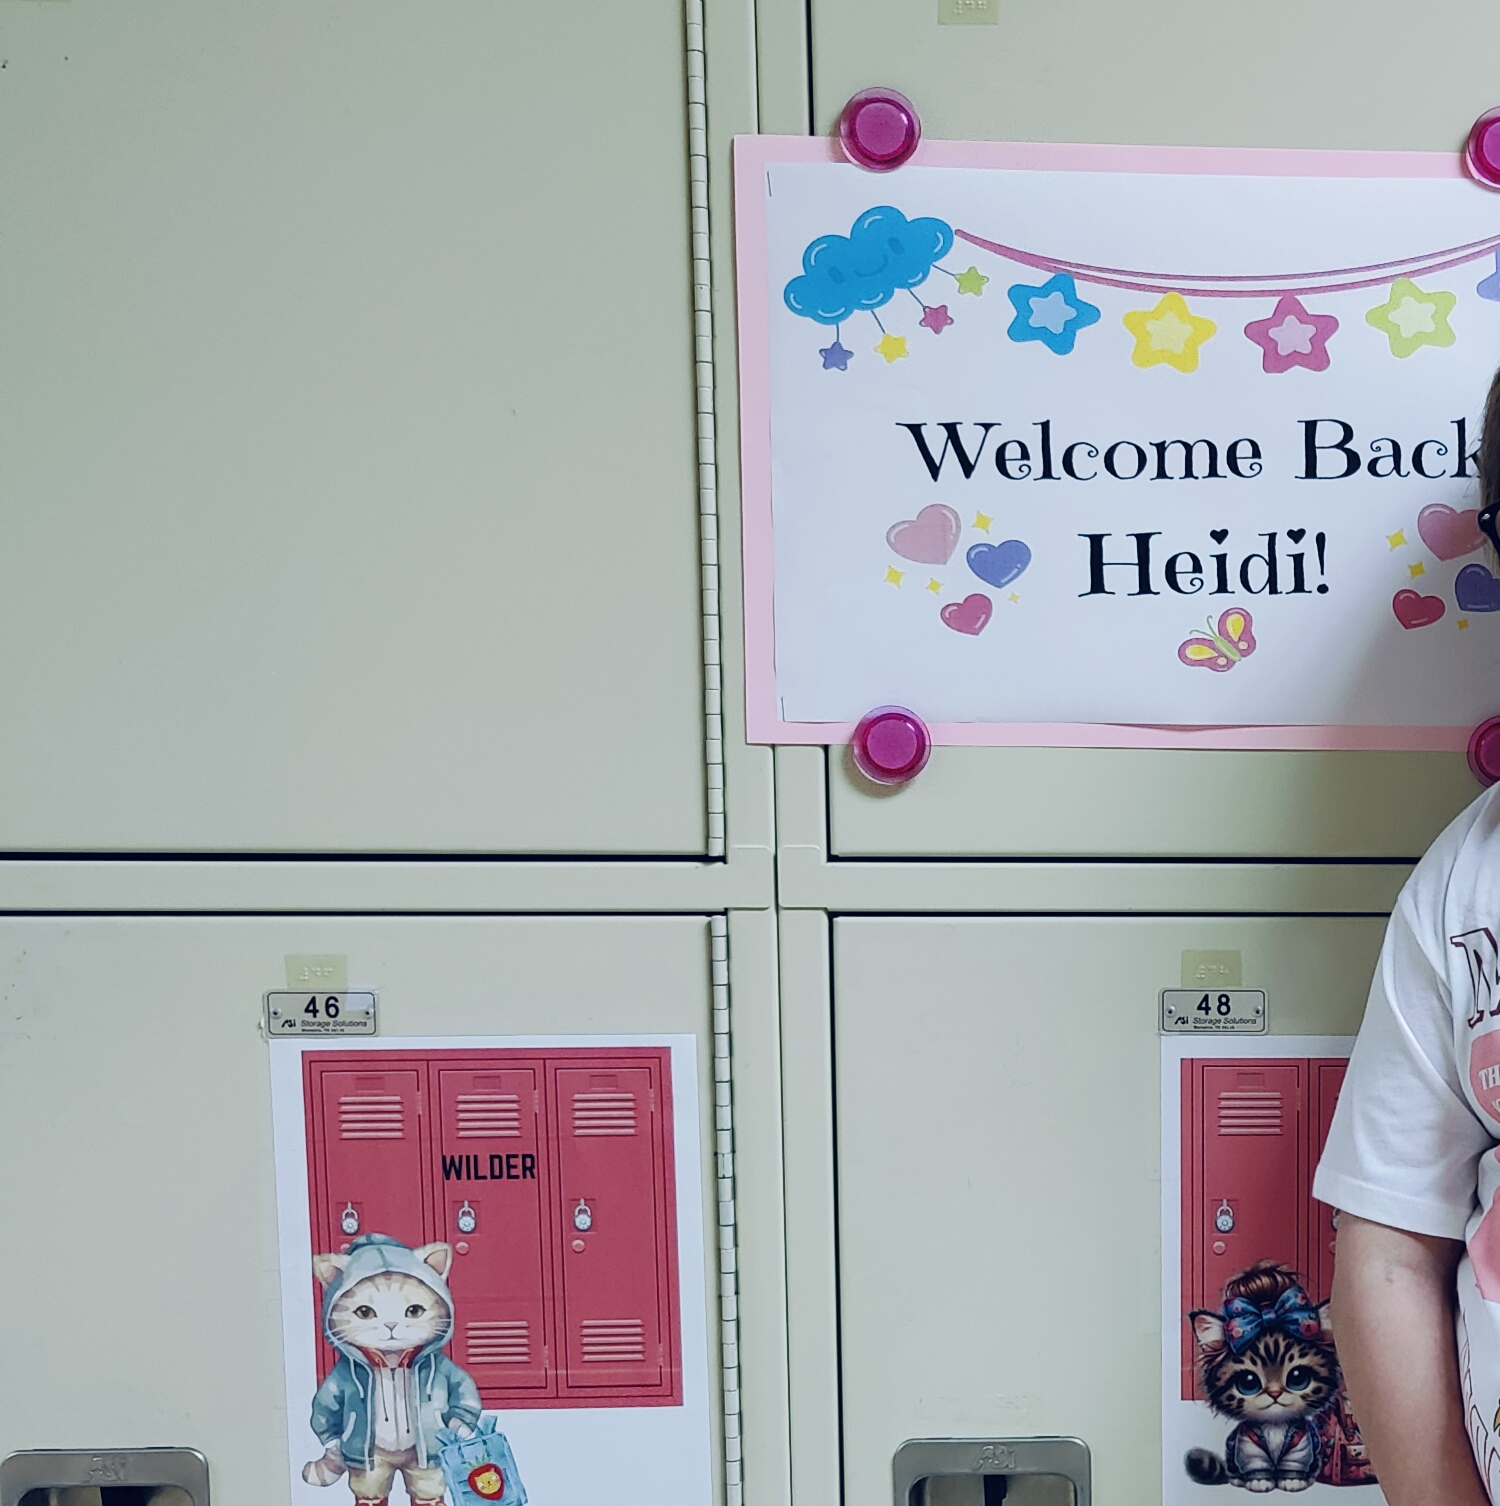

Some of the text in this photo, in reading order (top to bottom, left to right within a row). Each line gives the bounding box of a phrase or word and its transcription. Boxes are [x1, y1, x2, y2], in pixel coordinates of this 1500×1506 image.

[896, 417, 1482, 483] Welcome Back
[1078, 528, 1329, 598] Heidi!
[304, 995, 340, 1019] 46
[1196, 993, 1232, 1016] 48
[300, 1020, 331, 1028] Storage
[332, 1020, 368, 1028] Solutions
[1192, 1017, 1222, 1026] Storage
[1223, 1017, 1257, 1025] Solutions
[441, 1153, 536, 1181] WILDER
